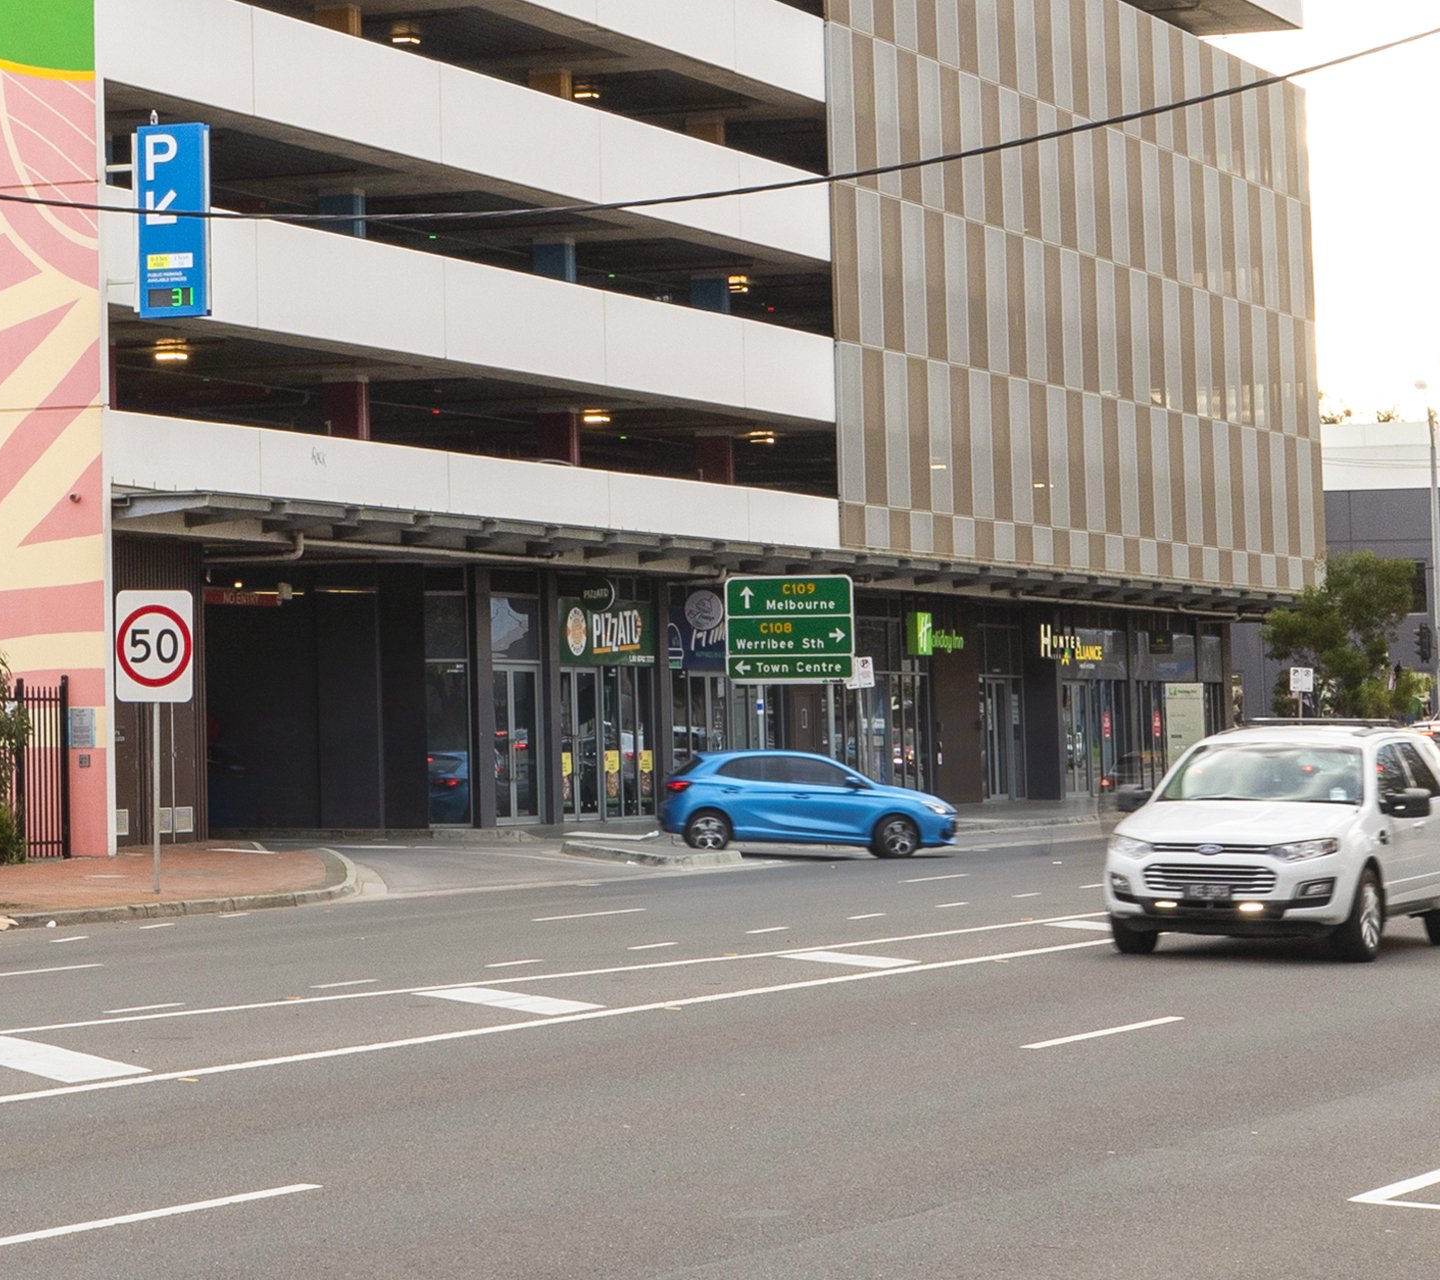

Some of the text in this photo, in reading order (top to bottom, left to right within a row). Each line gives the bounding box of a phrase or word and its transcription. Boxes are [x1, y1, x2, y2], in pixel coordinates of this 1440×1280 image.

[146, 134, 177, 181] P
[171, 287, 194, 307] 31
[782, 583, 815, 595] C109
[224, 591, 235, 605] NO
[766, 599, 835, 610] Melbourne
[592, 609, 642, 652] PIZZATO
[760, 623, 792, 634] C108
[130, 628, 178, 664] 50
[736, 638, 824, 650] Werribee Sth
[756, 661, 842, 673] Town Centre
